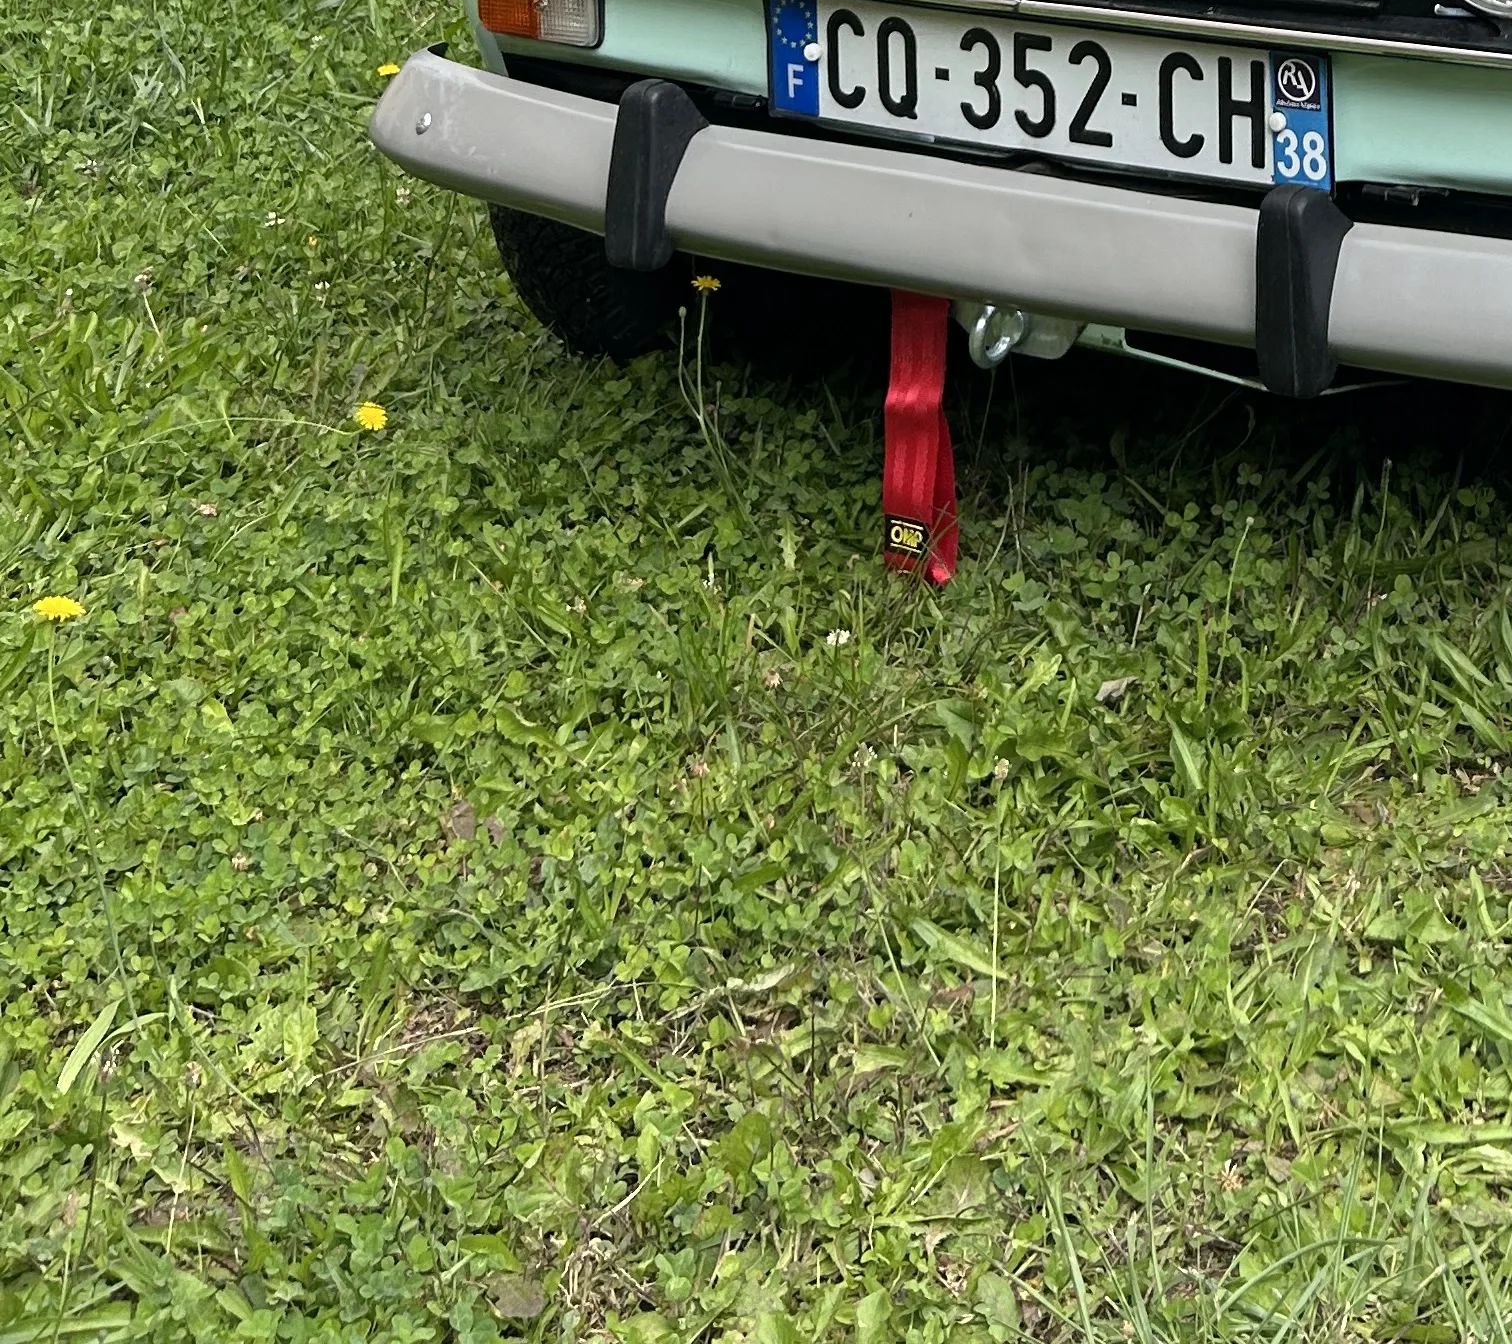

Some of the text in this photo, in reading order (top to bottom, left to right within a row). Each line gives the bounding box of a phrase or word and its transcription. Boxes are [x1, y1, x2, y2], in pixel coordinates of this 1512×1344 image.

[787, 63, 805, 99] F
[826, 8, 1266, 169] CQ-352-CH
[1276, 128, 1327, 180] 38
